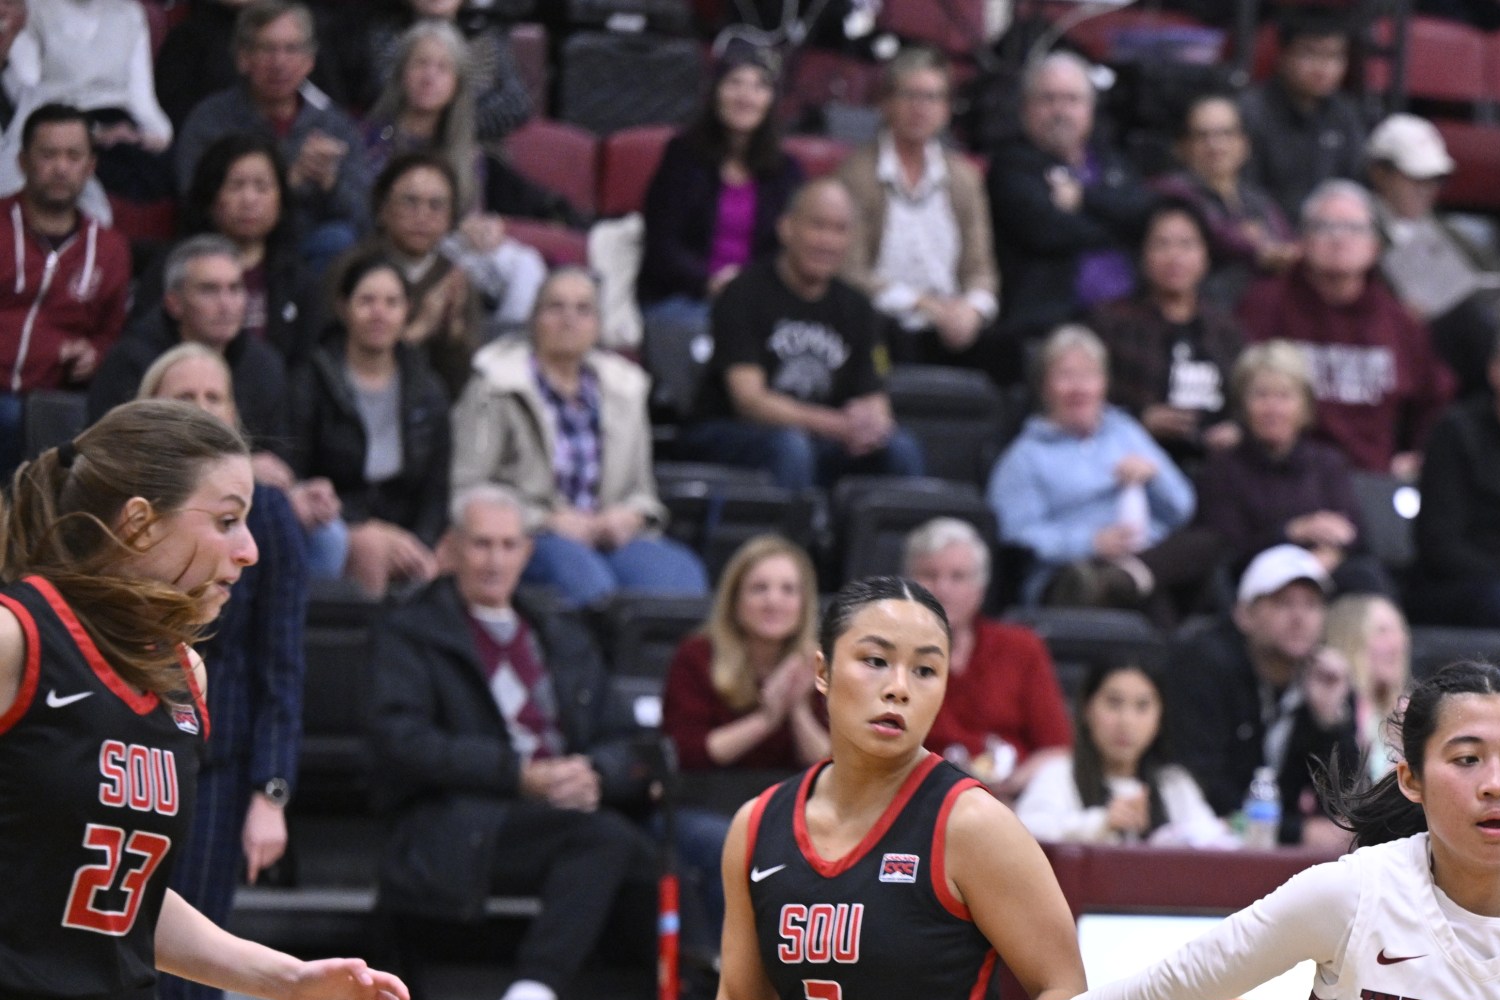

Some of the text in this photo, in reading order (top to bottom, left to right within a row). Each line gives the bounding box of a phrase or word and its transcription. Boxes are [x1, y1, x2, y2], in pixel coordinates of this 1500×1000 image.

[99, 738, 179, 817] SOU
[61, 822, 171, 936] 23
[778, 903, 864, 964] SOU
